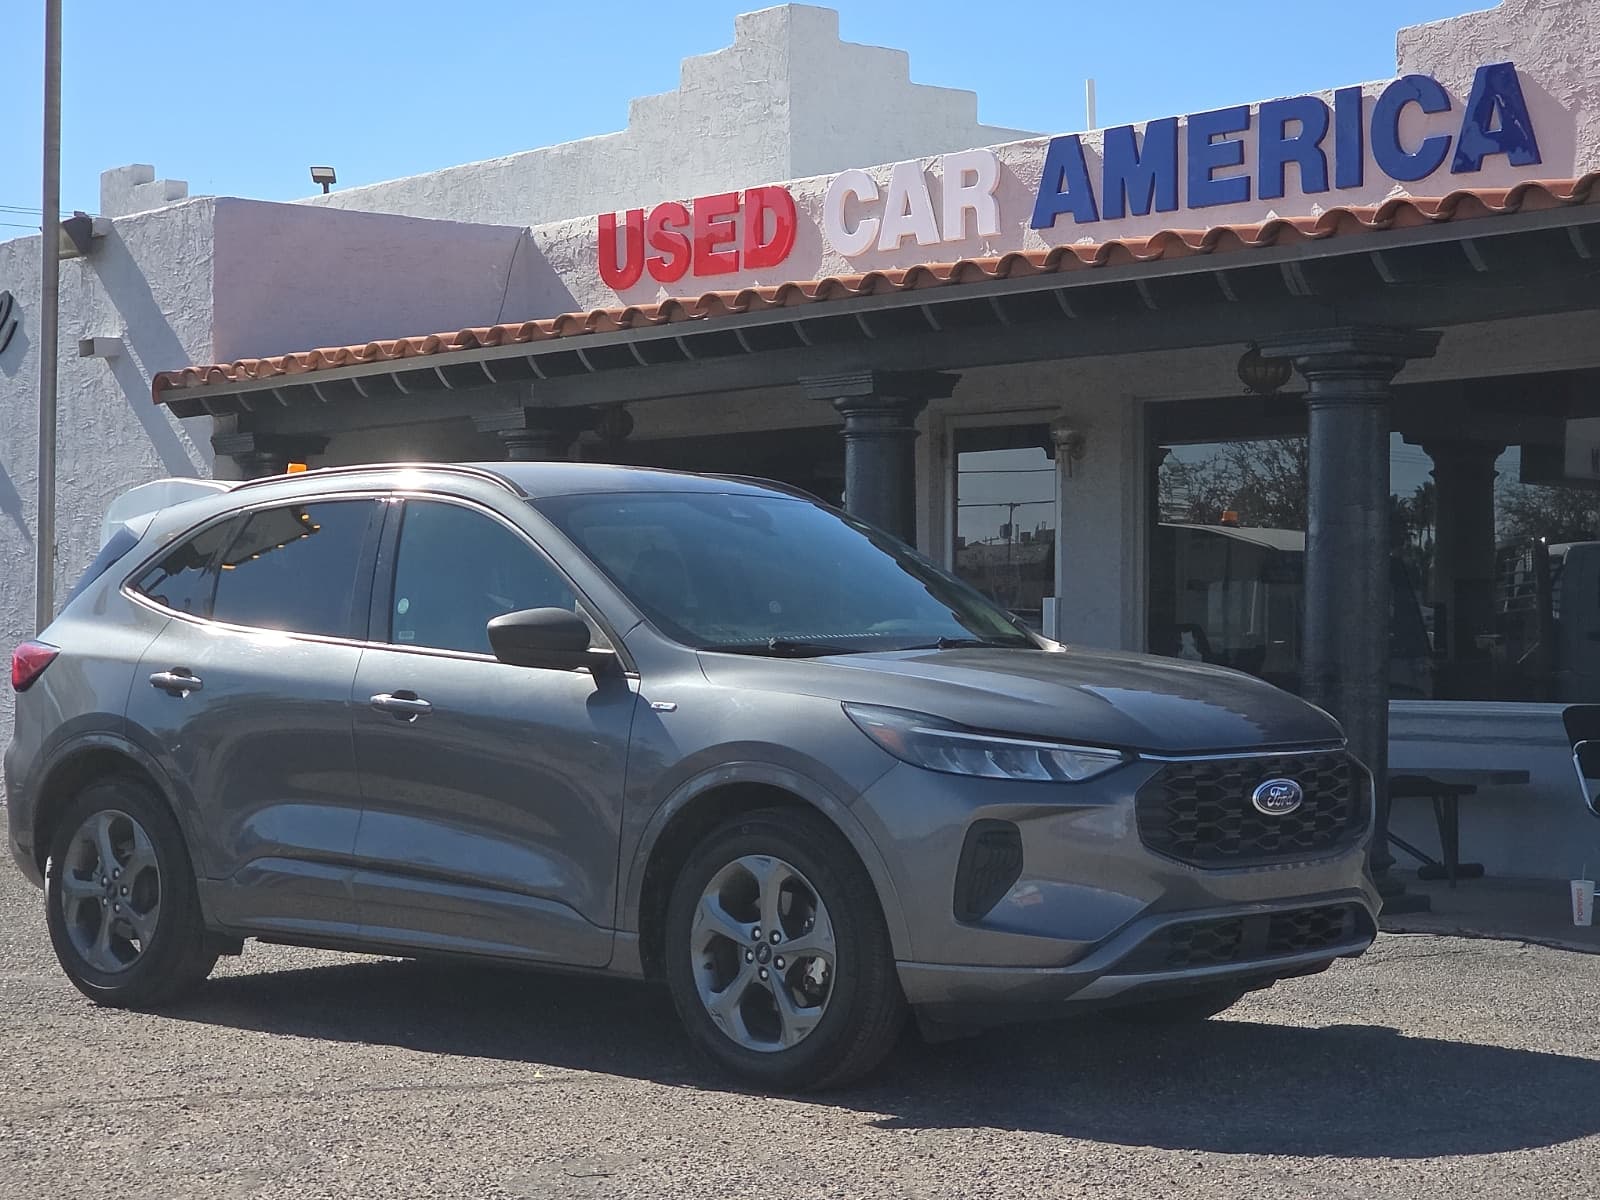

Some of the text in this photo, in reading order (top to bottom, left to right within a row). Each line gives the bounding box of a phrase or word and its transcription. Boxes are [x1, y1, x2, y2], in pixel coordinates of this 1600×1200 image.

[598, 62, 1542, 290] USED CAR AMERICA
